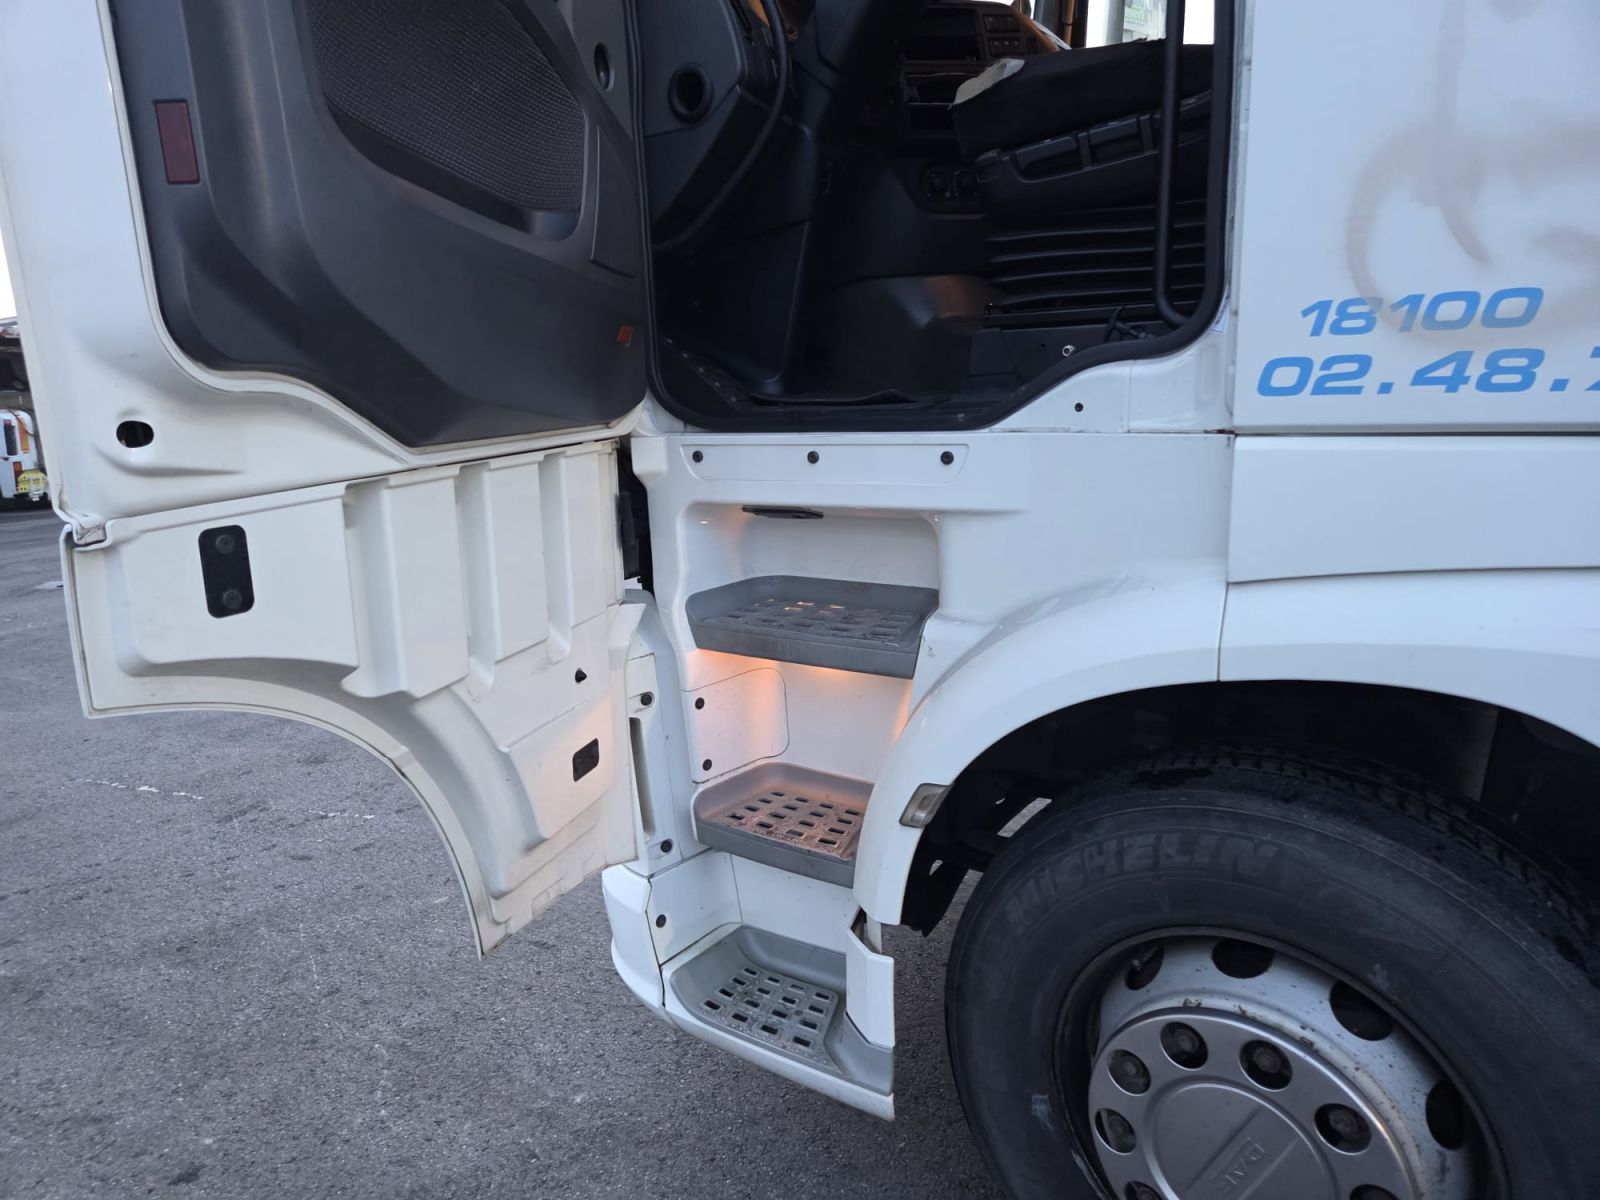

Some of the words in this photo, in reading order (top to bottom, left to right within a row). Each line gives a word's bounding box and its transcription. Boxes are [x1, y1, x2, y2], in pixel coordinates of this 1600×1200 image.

[1300, 287, 1544, 337] 18100
[1257, 346, 1600, 397] 02.48.
[1004, 832, 1280, 934] MICHELIN
[1217, 1137, 1267, 1195] DAF
